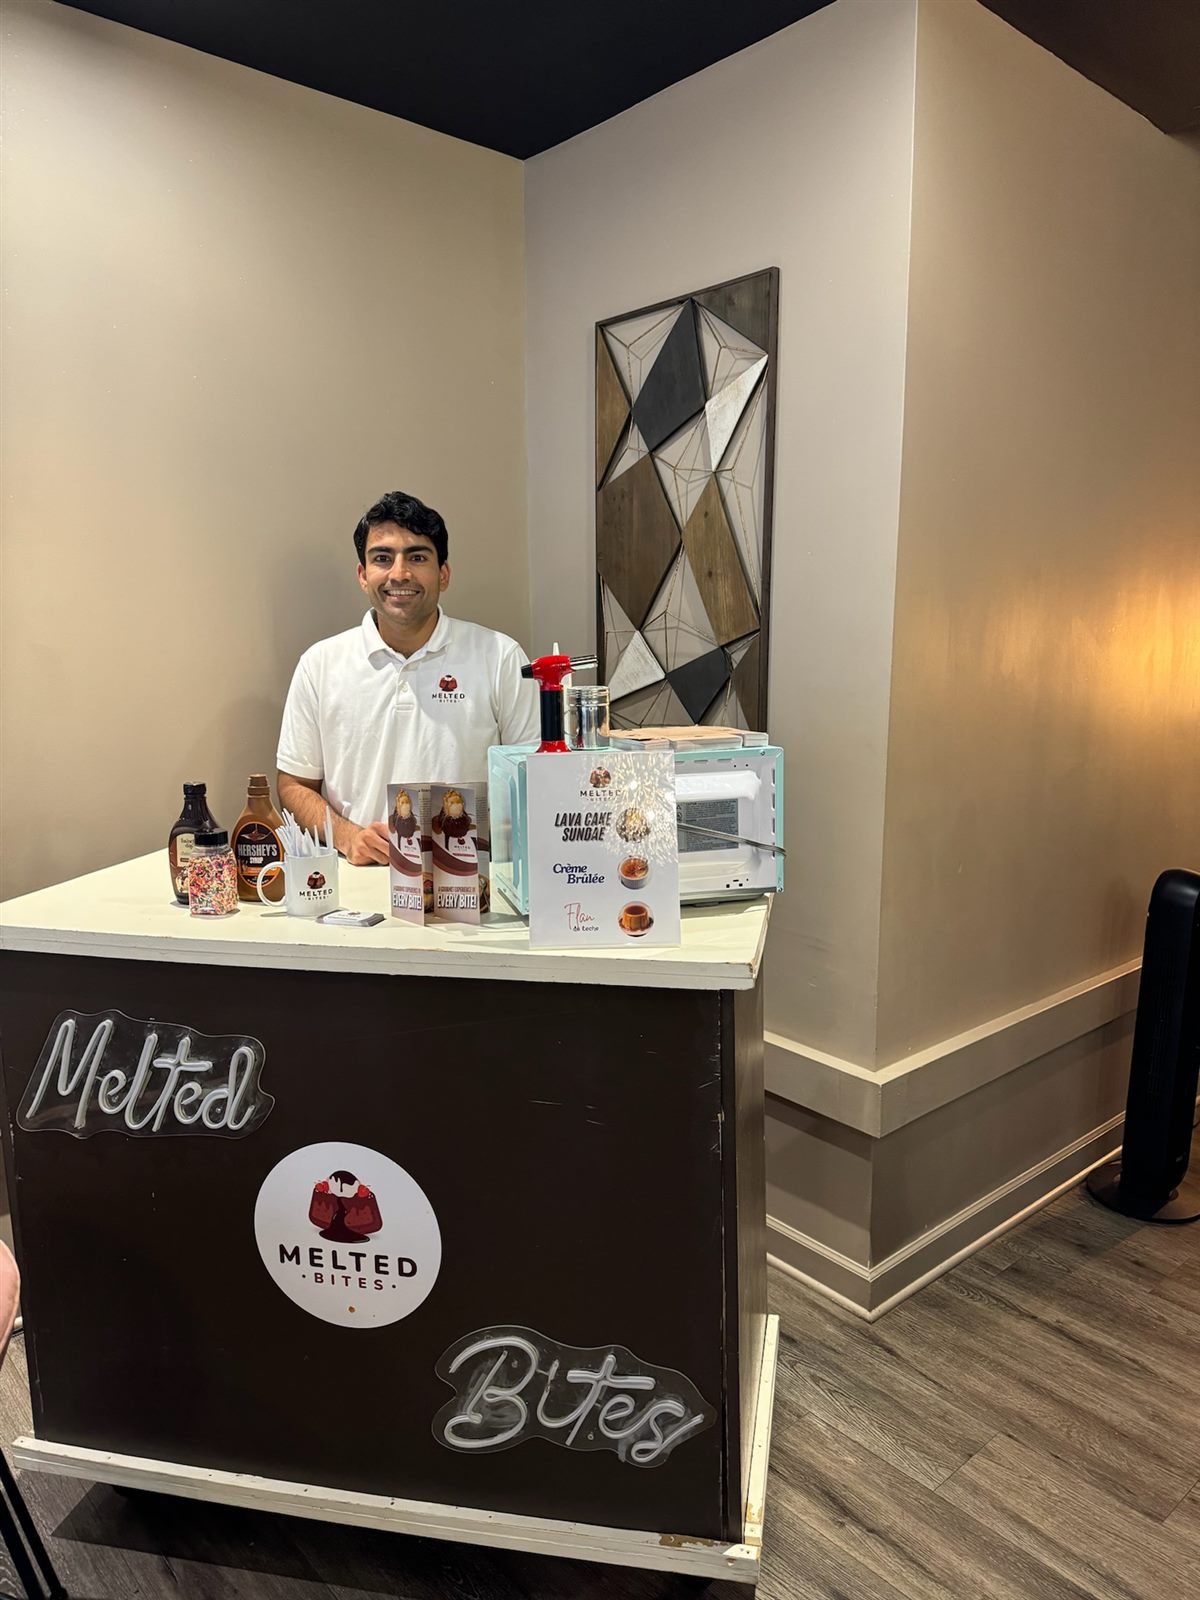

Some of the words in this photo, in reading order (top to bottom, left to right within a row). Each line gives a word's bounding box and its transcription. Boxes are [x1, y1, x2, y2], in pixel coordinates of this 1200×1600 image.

[554, 812, 582, 827] LAVA
[584, 812, 613, 827] CAKE
[562, 827, 606, 842] SUNDAE
[237, 844, 278, 857] HERSHEY'S
[553, 863, 587, 874] Crème
[567, 873, 605, 884] Brûlée
[299, 888, 333, 897] MELTED
[437, 893, 459, 908] EVERY
[459, 894, 477, 909] BITE!
[564, 902, 595, 930] Flan
[26, 1019, 256, 1132] Melted
[279, 1243, 418, 1278] MELTED
[314, 1272, 384, 1291] BITES
[444, 1336, 705, 1463] Bites
